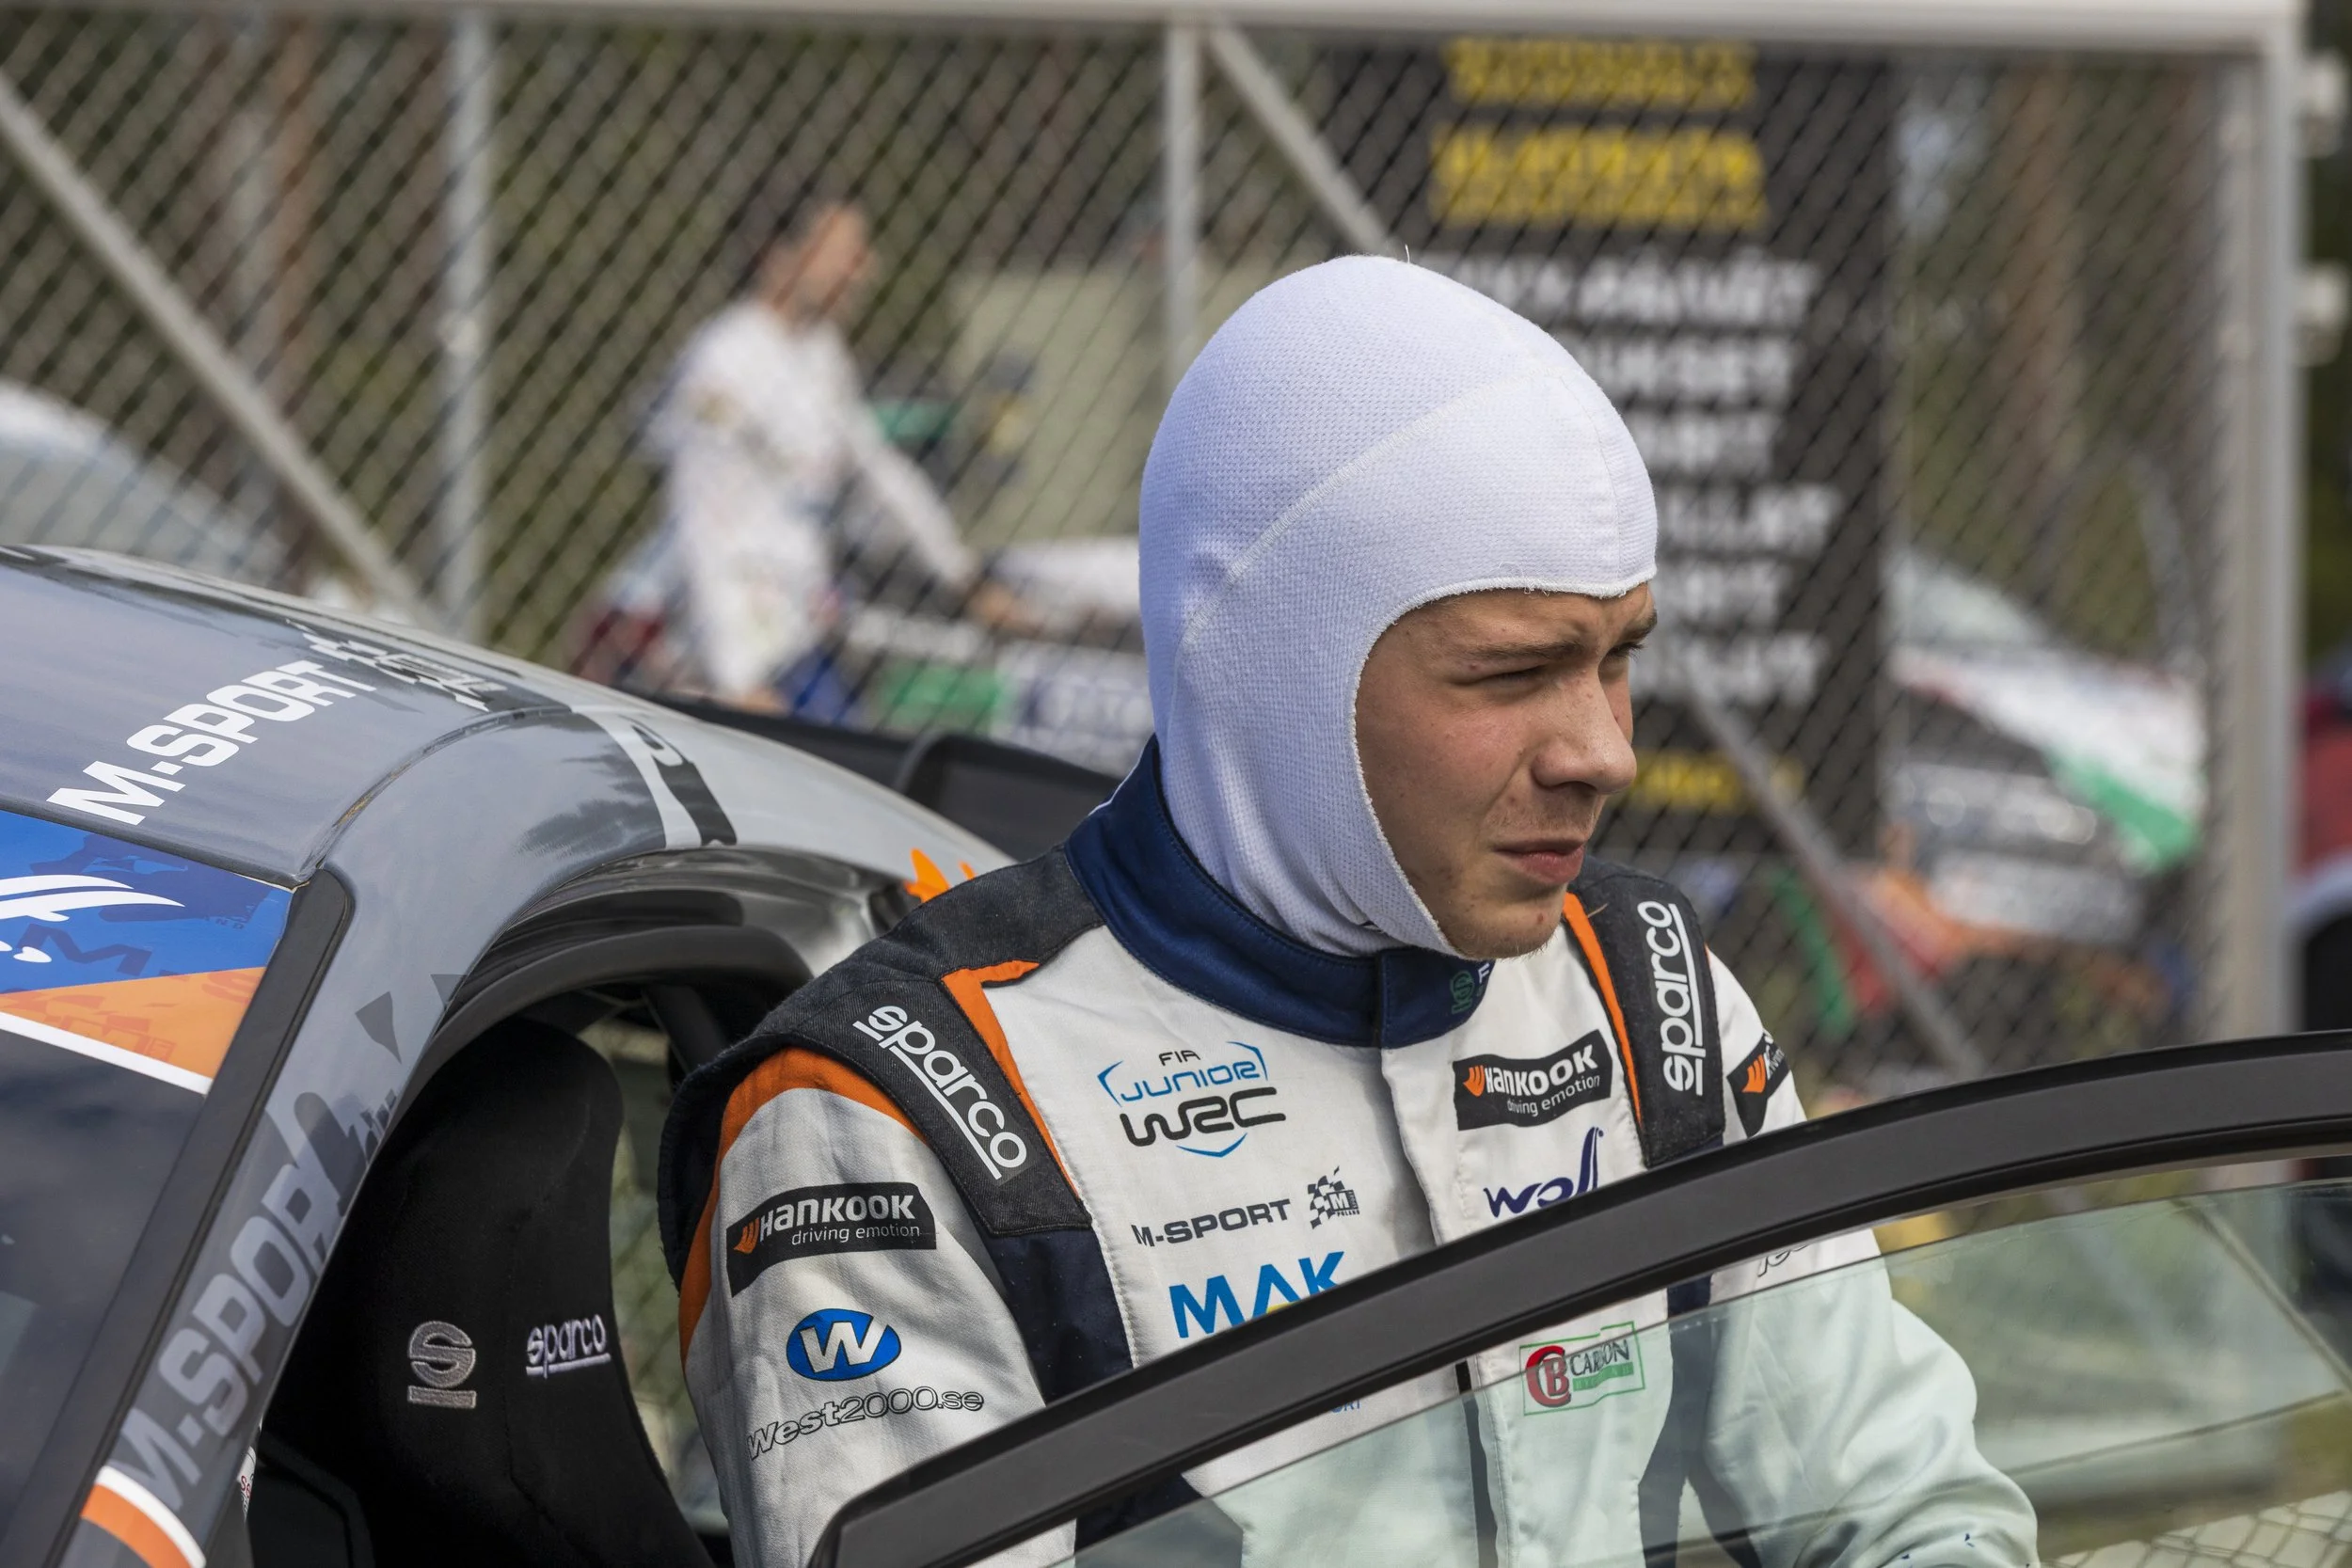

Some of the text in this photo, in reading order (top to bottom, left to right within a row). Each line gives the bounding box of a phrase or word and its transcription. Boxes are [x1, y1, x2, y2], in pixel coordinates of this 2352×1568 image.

[46, 660, 376, 825] M-SPORT
[1637, 900, 1706, 1092] sparco
[867, 1005, 1027, 1169] sparco
[1120, 1060, 1261, 1101] JUNIOR
[1158, 1049, 1200, 1066] FIA
[1120, 1086, 1286, 1147] WRC
[1507, 1074, 1600, 1117] driving emotion
[791, 1224, 920, 1245] driving emotion
[1131, 1199, 1291, 1247] M-SPORT
[1169, 1251, 1344, 1338] MAK
[108, 1163, 342, 1510] M-SPOR
[527, 1314, 608, 1379] sparco
[799, 1321, 896, 1373] W
